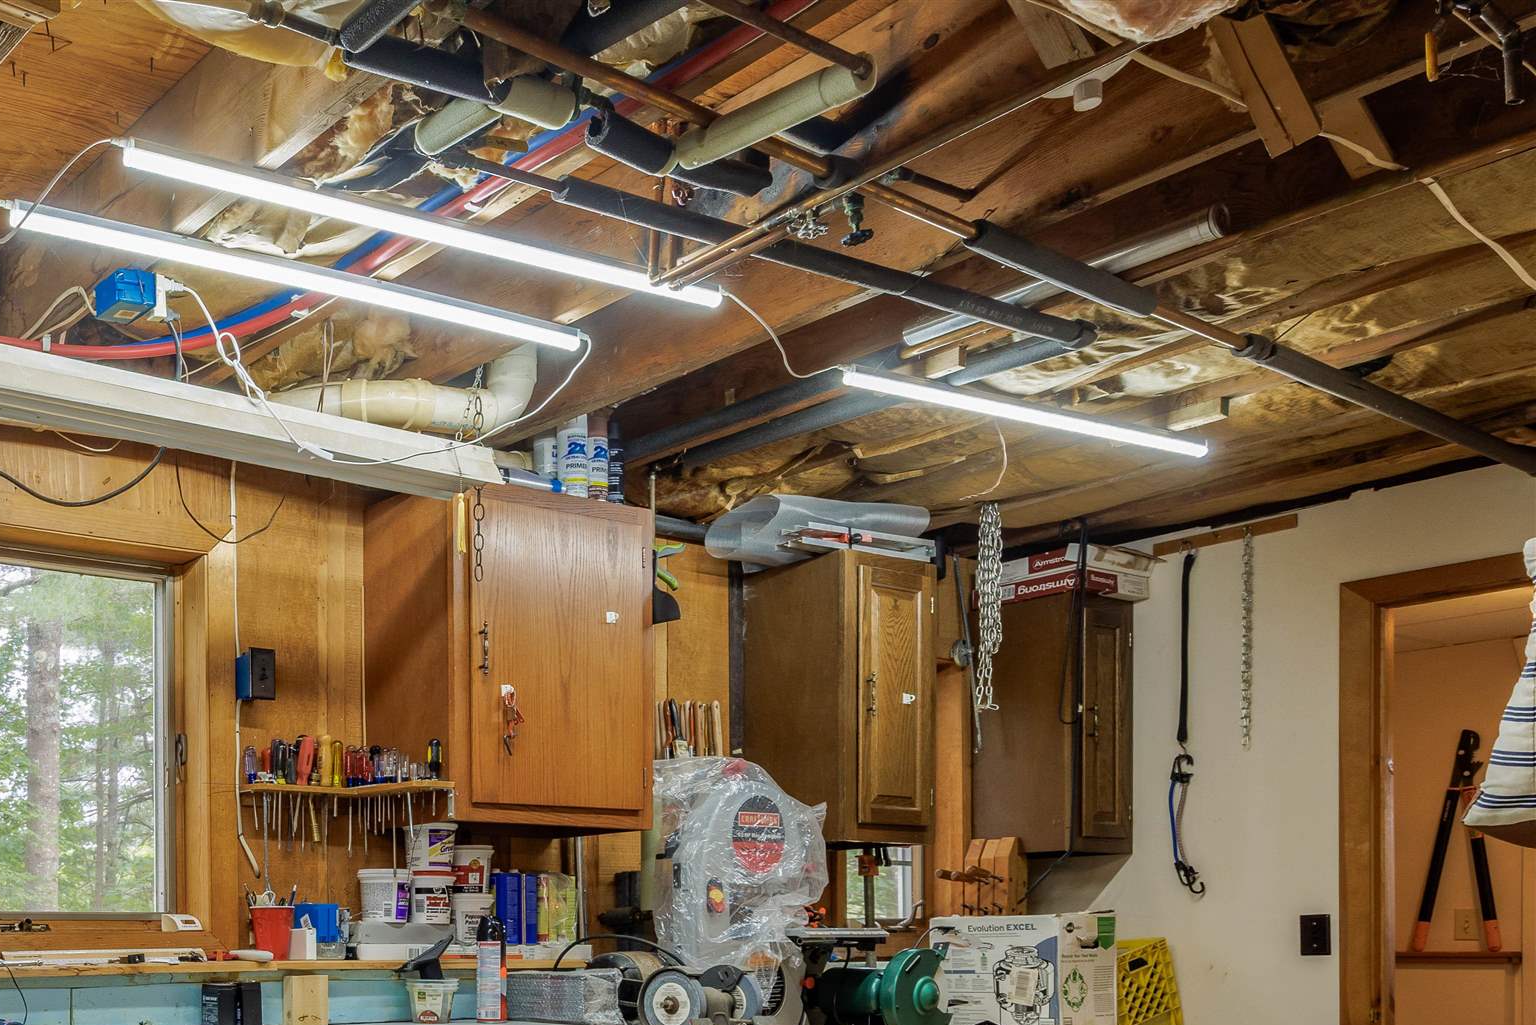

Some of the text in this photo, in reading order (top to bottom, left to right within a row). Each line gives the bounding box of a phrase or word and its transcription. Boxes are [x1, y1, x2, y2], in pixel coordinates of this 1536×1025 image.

[1033, 557, 1065, 568] Armstro
[1017, 578, 1076, 595] Armstrong
[967, 923, 1037, 933] Evolution EXCEL
